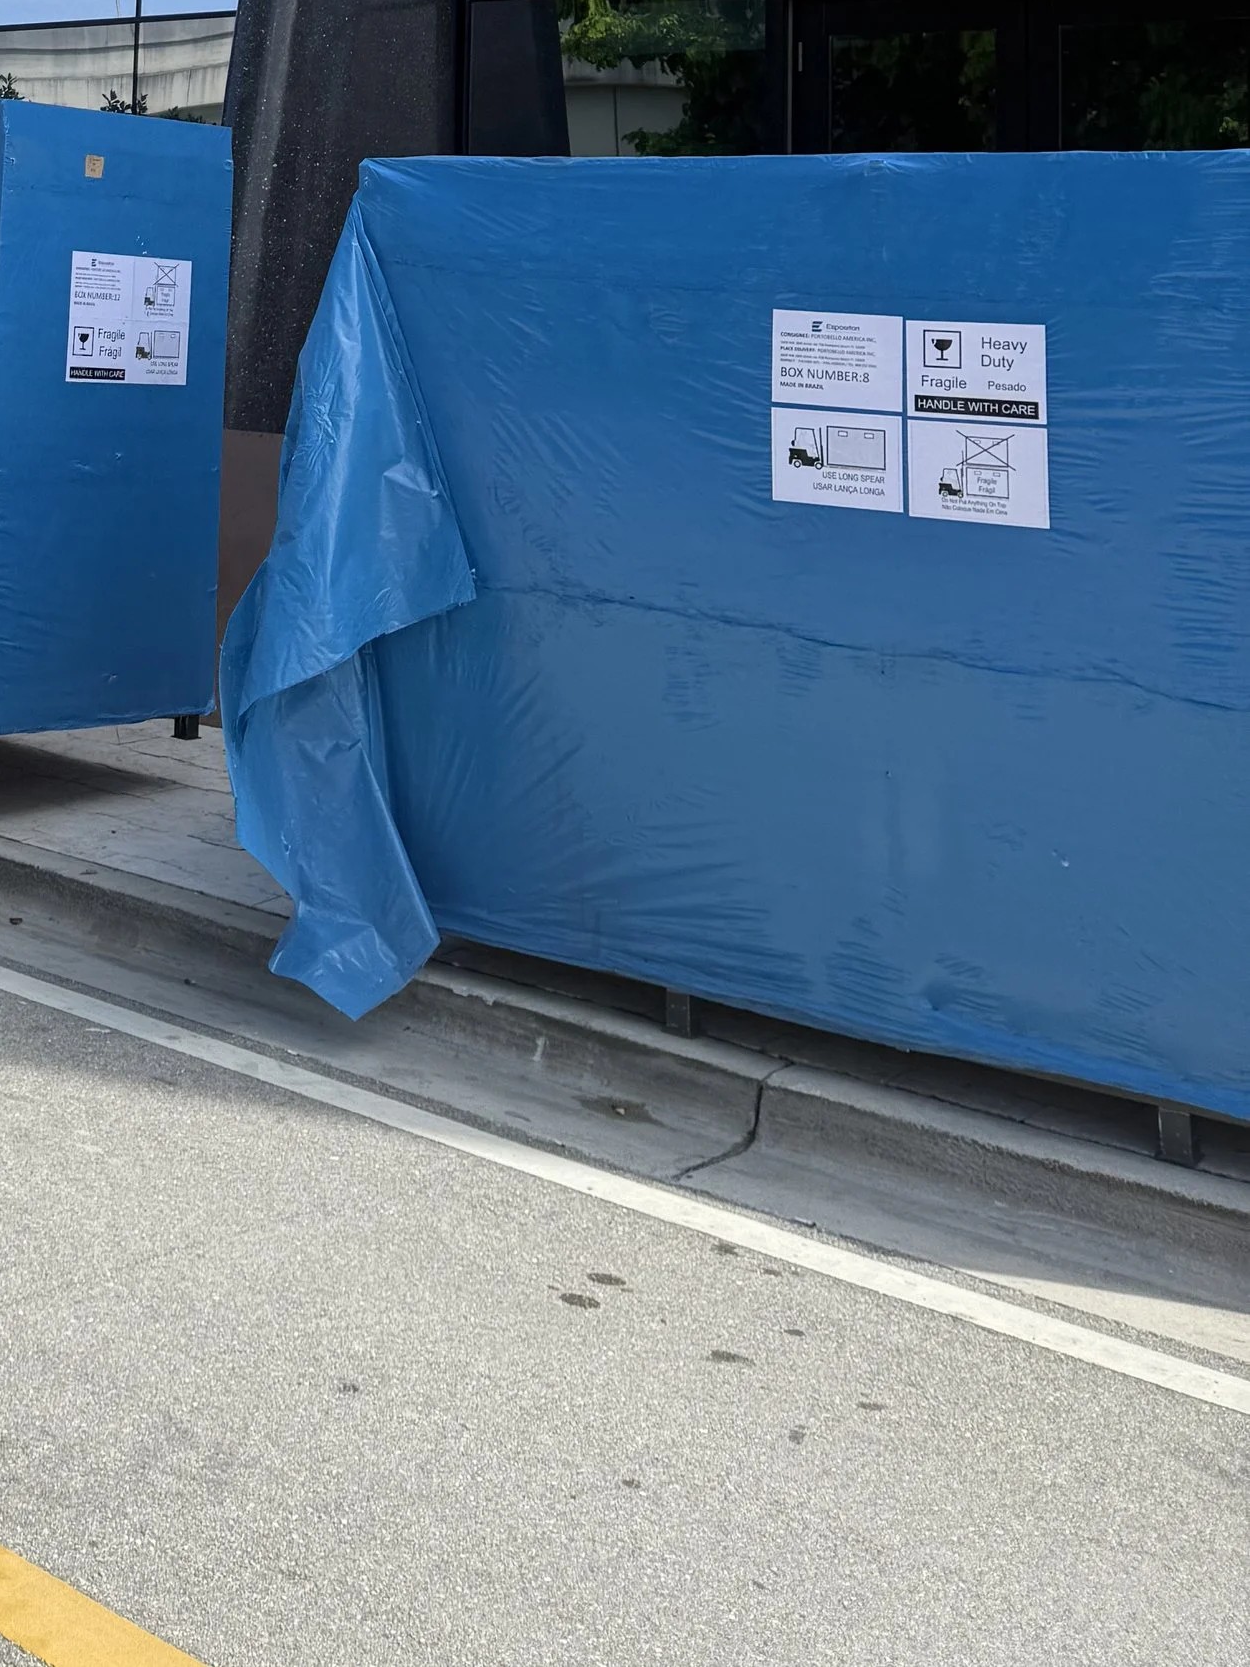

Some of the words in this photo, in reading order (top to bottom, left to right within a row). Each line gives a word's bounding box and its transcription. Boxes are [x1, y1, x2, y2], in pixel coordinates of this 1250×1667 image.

[98, 328, 125, 342] Fragile
[981, 336, 1028, 354] Heavy
[981, 354, 1014, 371] Duty
[70, 368, 93, 377] HANDLE
[94, 369, 109, 378] WITH
[109, 370, 125, 378] CARE
[780, 366, 804, 378] BOX
[807, 368, 870, 383] NUMBER:8
[921, 375, 967, 391] Fragile
[988, 380, 1027, 392] Pesado
[918, 398, 965, 411] HANDLE
[967, 401, 999, 413] WITH
[1001, 403, 1036, 416] CARE
[822, 471, 837, 480] USE
[838, 472, 859, 482] LONG
[861, 474, 885, 484] SPEAR
[976, 476, 997, 486] Fragile
[813, 482, 832, 491] USAR
[834, 484, 858, 494] LANÇA
[859, 486, 885, 496] LONGA
